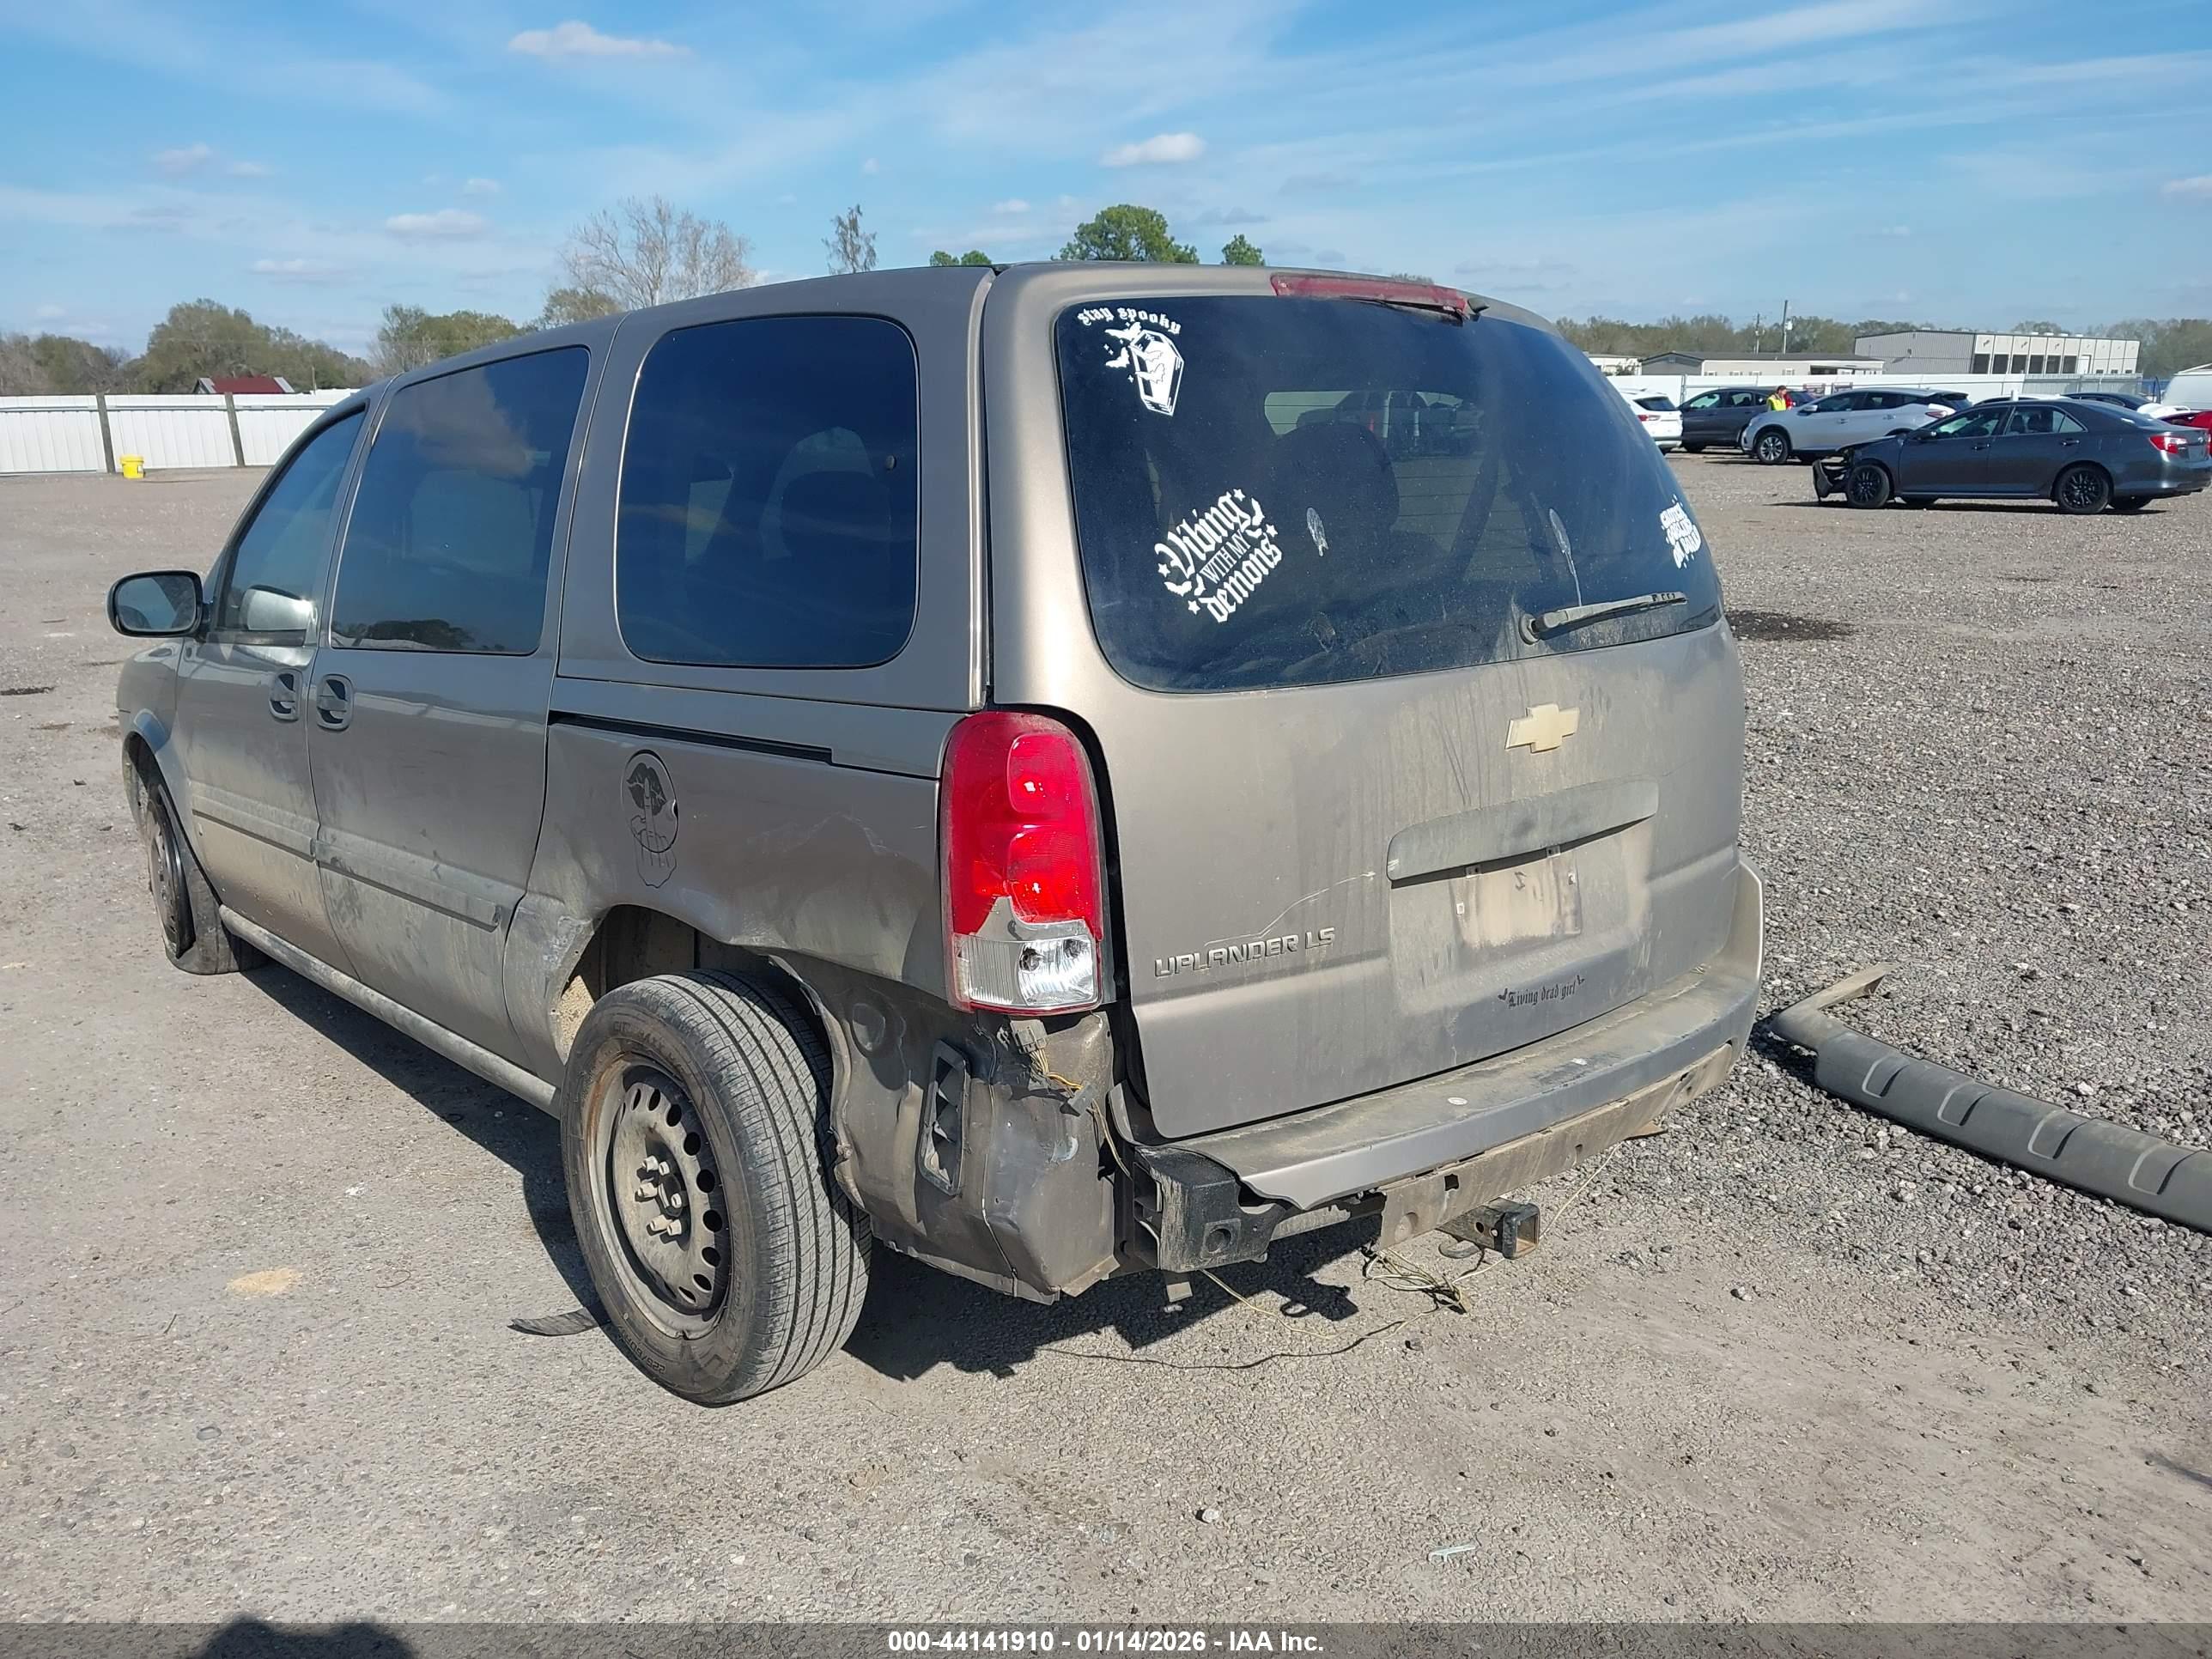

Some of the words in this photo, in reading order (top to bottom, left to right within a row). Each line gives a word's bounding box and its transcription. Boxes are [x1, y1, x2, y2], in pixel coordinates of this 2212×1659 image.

[1198, 532, 1282, 623] demons
[1199, 546, 1237, 584] WITH
[1224, 528, 1251, 559] MY
[1154, 934, 1299, 977] UPLANDER
[1304, 927, 1335, 950] LS
[1509, 988, 1539, 1007] Living
[1560, 980, 1577, 1000] girl
